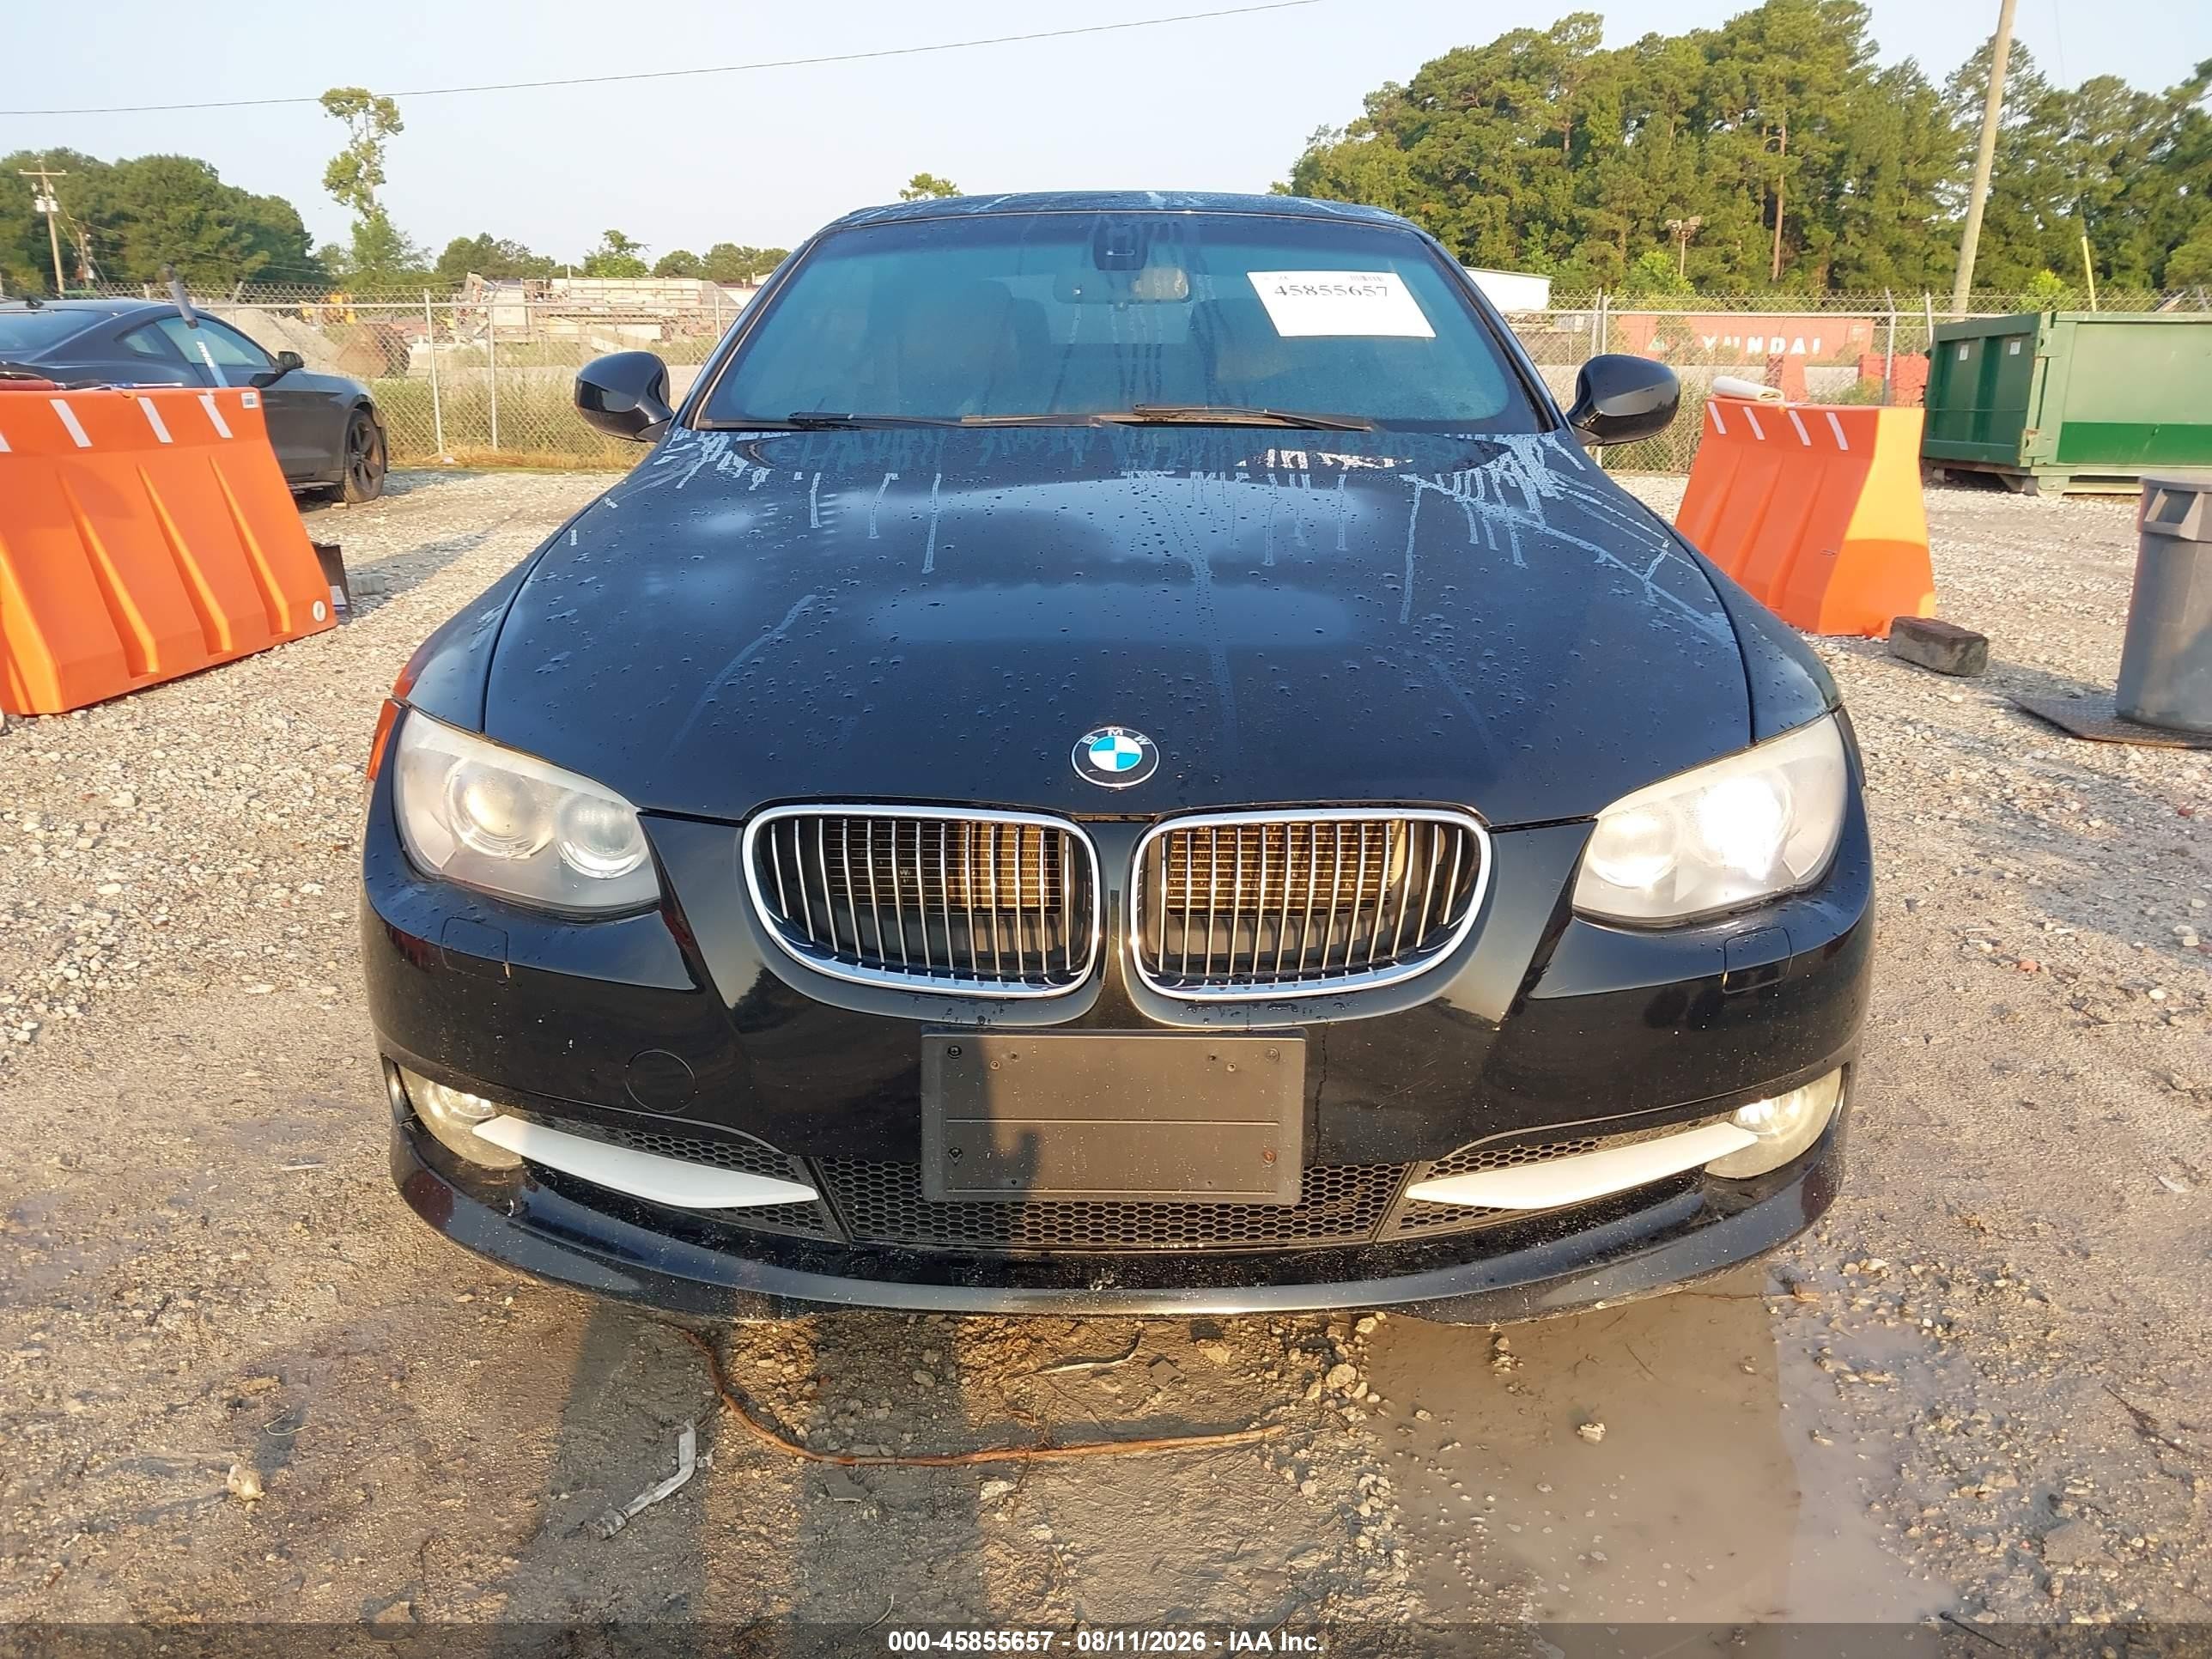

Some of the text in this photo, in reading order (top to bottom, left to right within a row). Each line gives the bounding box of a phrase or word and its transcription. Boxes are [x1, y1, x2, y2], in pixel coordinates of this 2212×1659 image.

[1273, 284, 1388, 297] 45855657
[1700, 335, 1821, 356] YUNDAI
[1082, 729, 1152, 746] BMW
